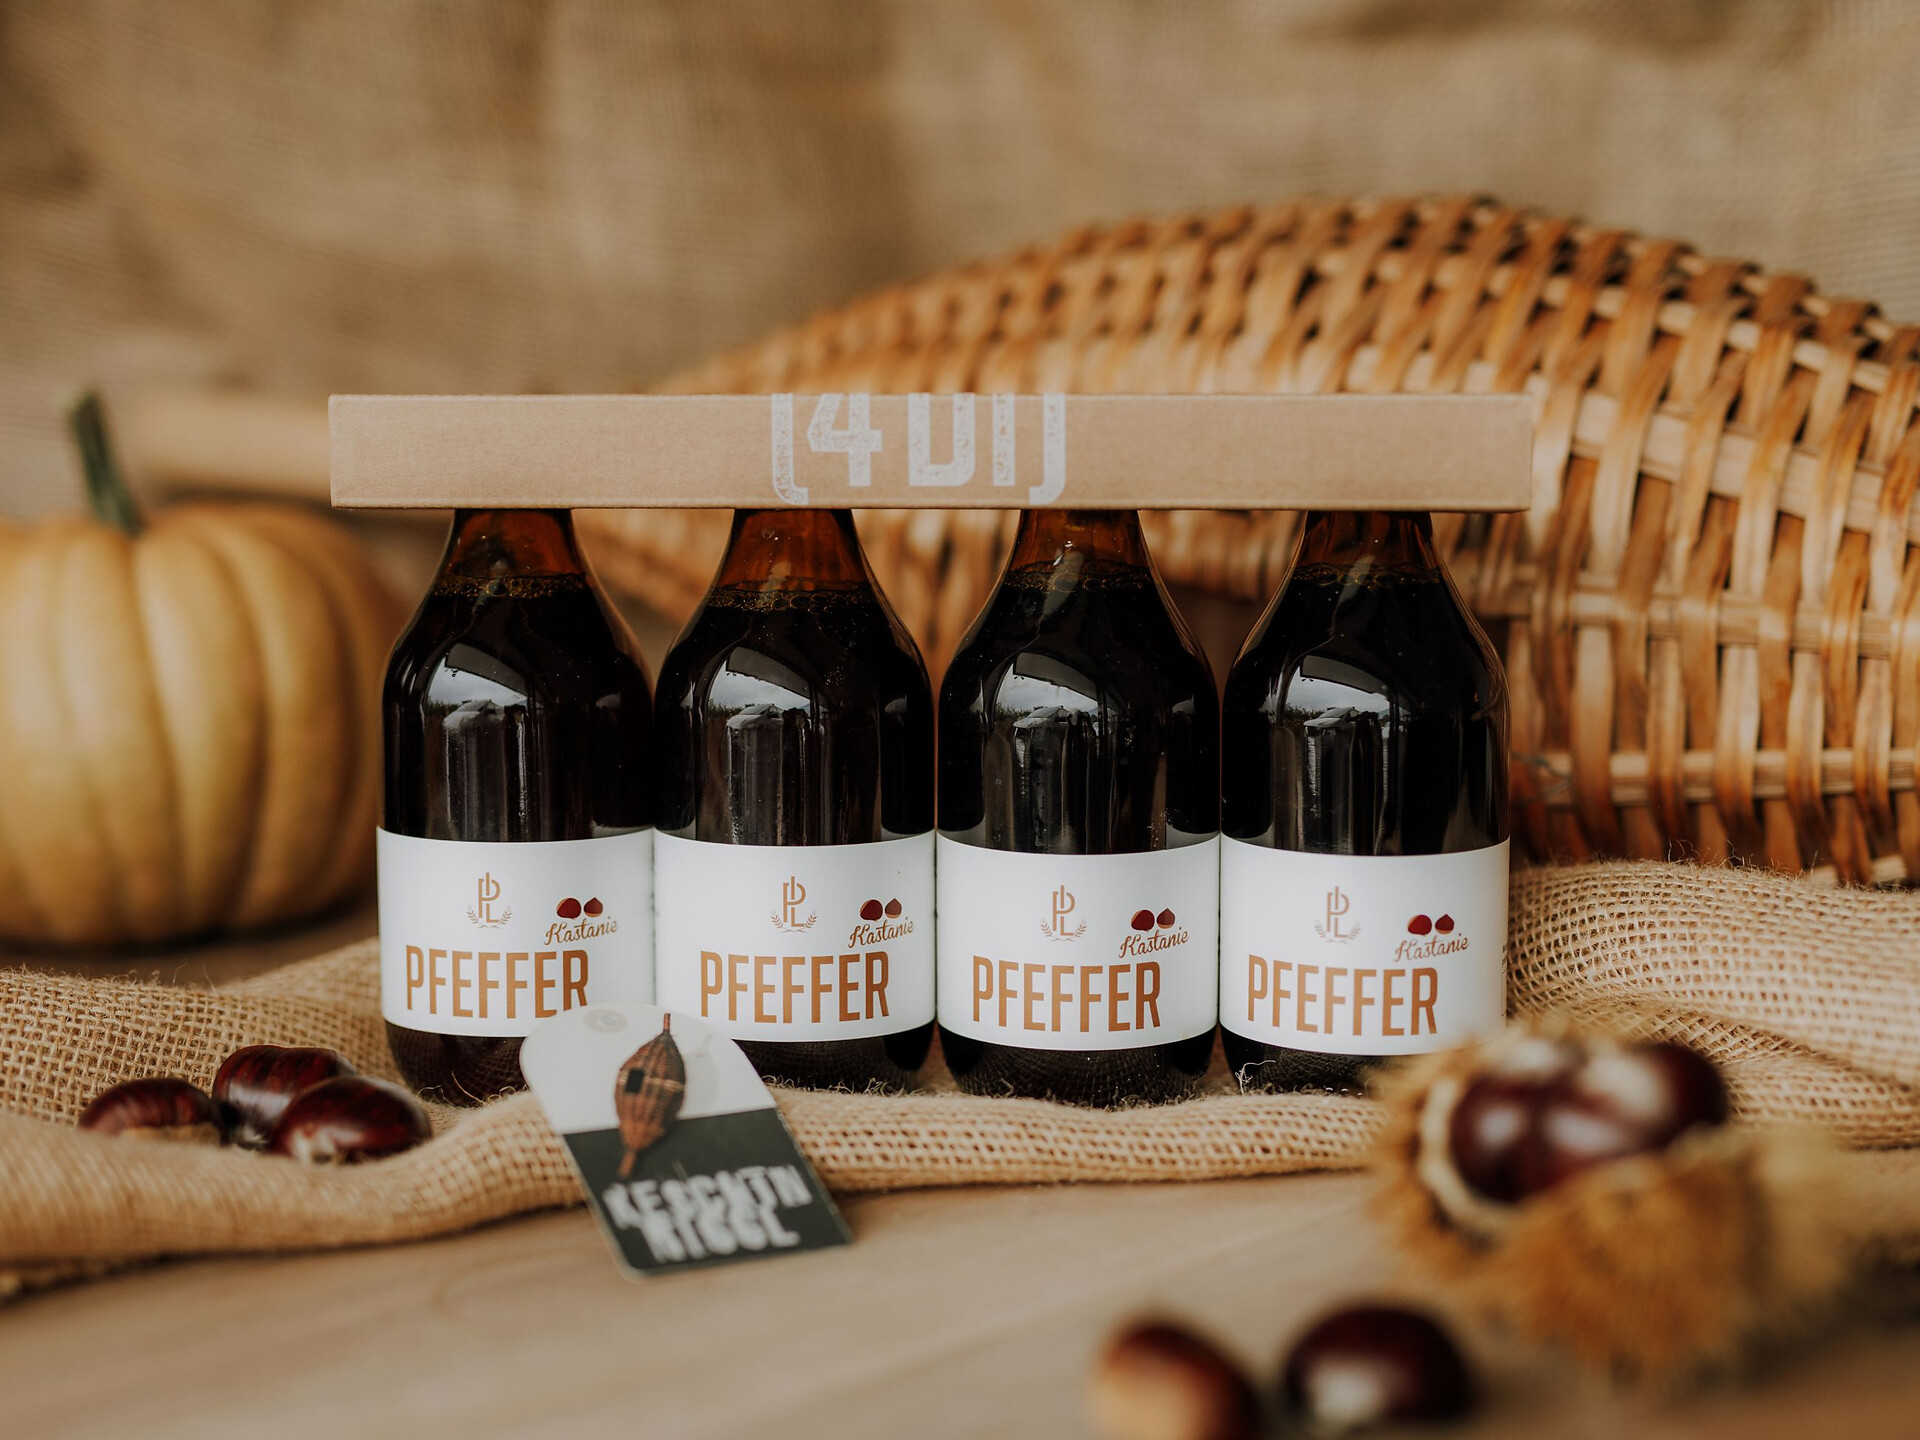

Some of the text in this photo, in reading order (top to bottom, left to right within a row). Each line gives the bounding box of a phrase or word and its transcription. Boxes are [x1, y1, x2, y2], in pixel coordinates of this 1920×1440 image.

[544, 915, 619, 946] Kastanie
[848, 916, 914, 949] Kastanie
[1118, 926, 1190, 959] Kastanie
[1393, 932, 1470, 963] Kastanie
[406, 944, 589, 1019] PFEFFER
[700, 950, 890, 1024] PFEFFER
[972, 954, 1162, 1033] PFEFFER
[1247, 953, 1439, 1037] PFEFFER
